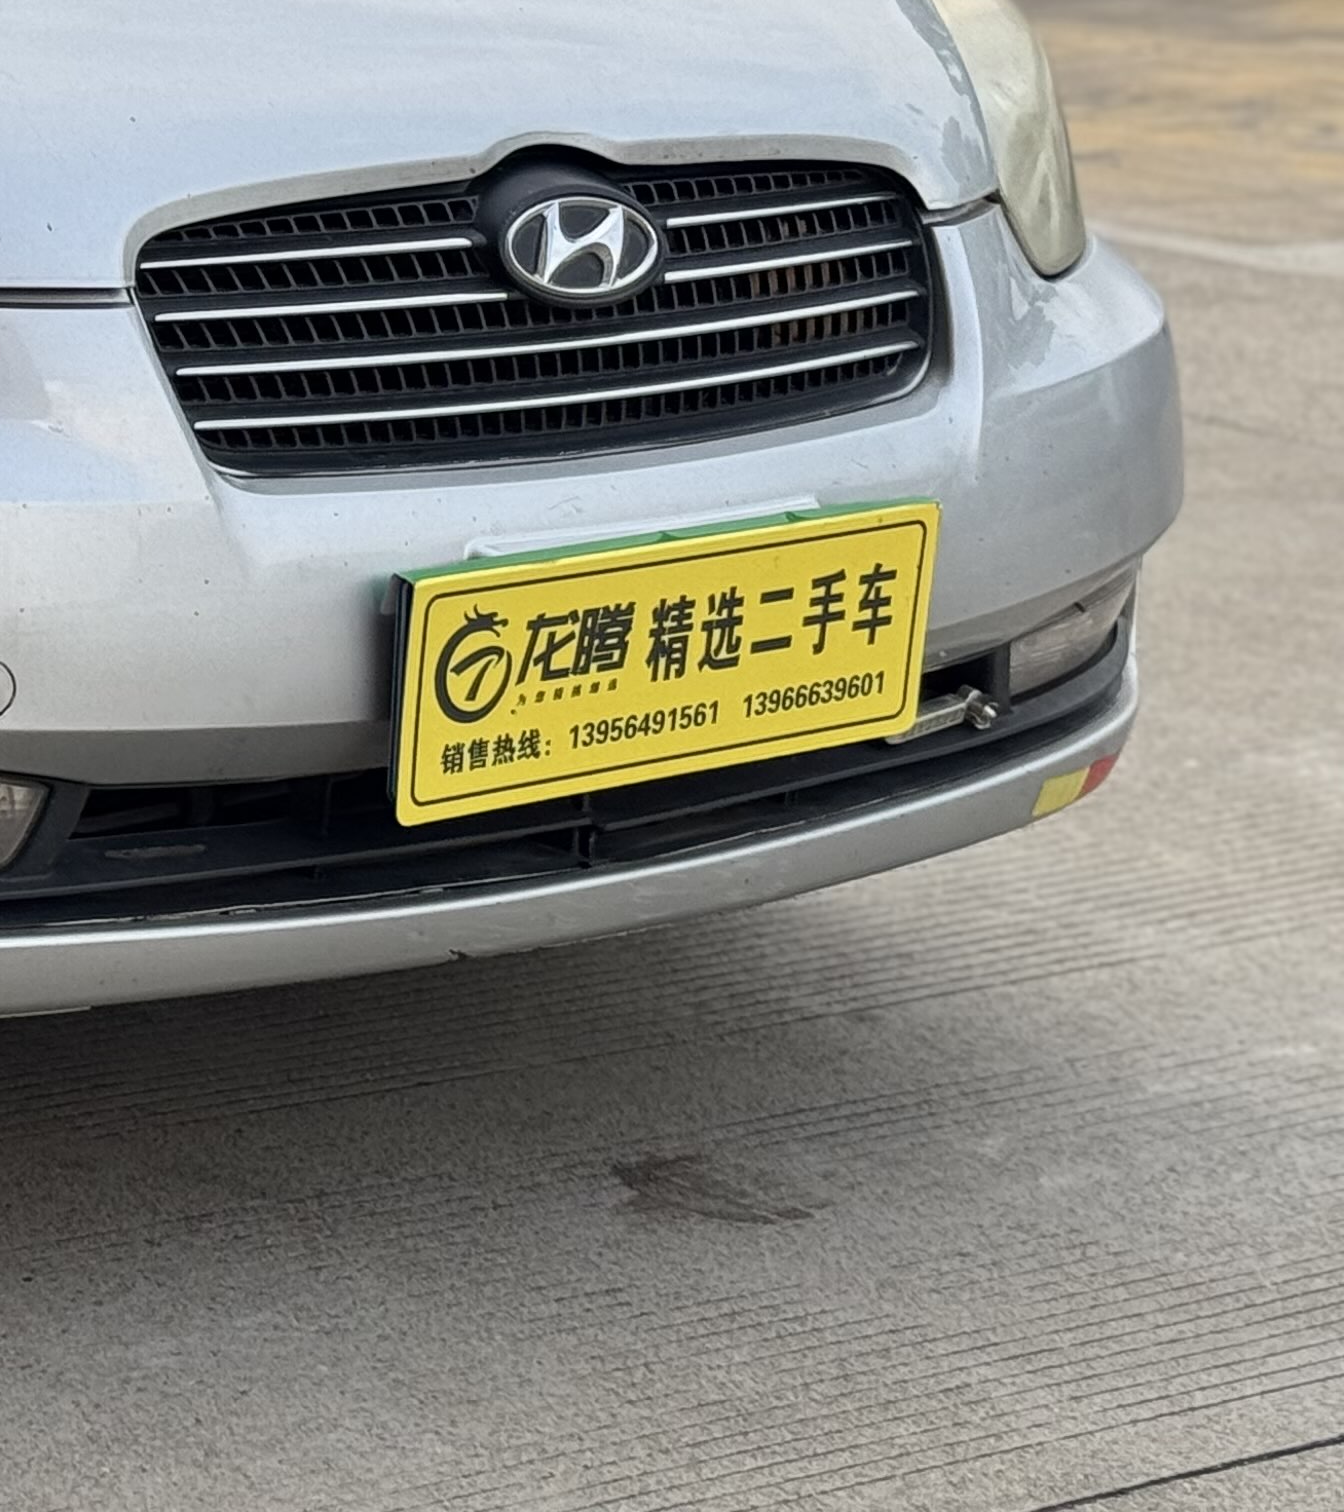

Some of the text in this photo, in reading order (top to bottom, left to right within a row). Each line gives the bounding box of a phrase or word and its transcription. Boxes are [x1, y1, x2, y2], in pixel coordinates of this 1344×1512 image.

[645, 563, 898, 682] 精选二手车
[569, 699, 719, 750] 13956491561
[742, 670, 885, 719] 13966639601
